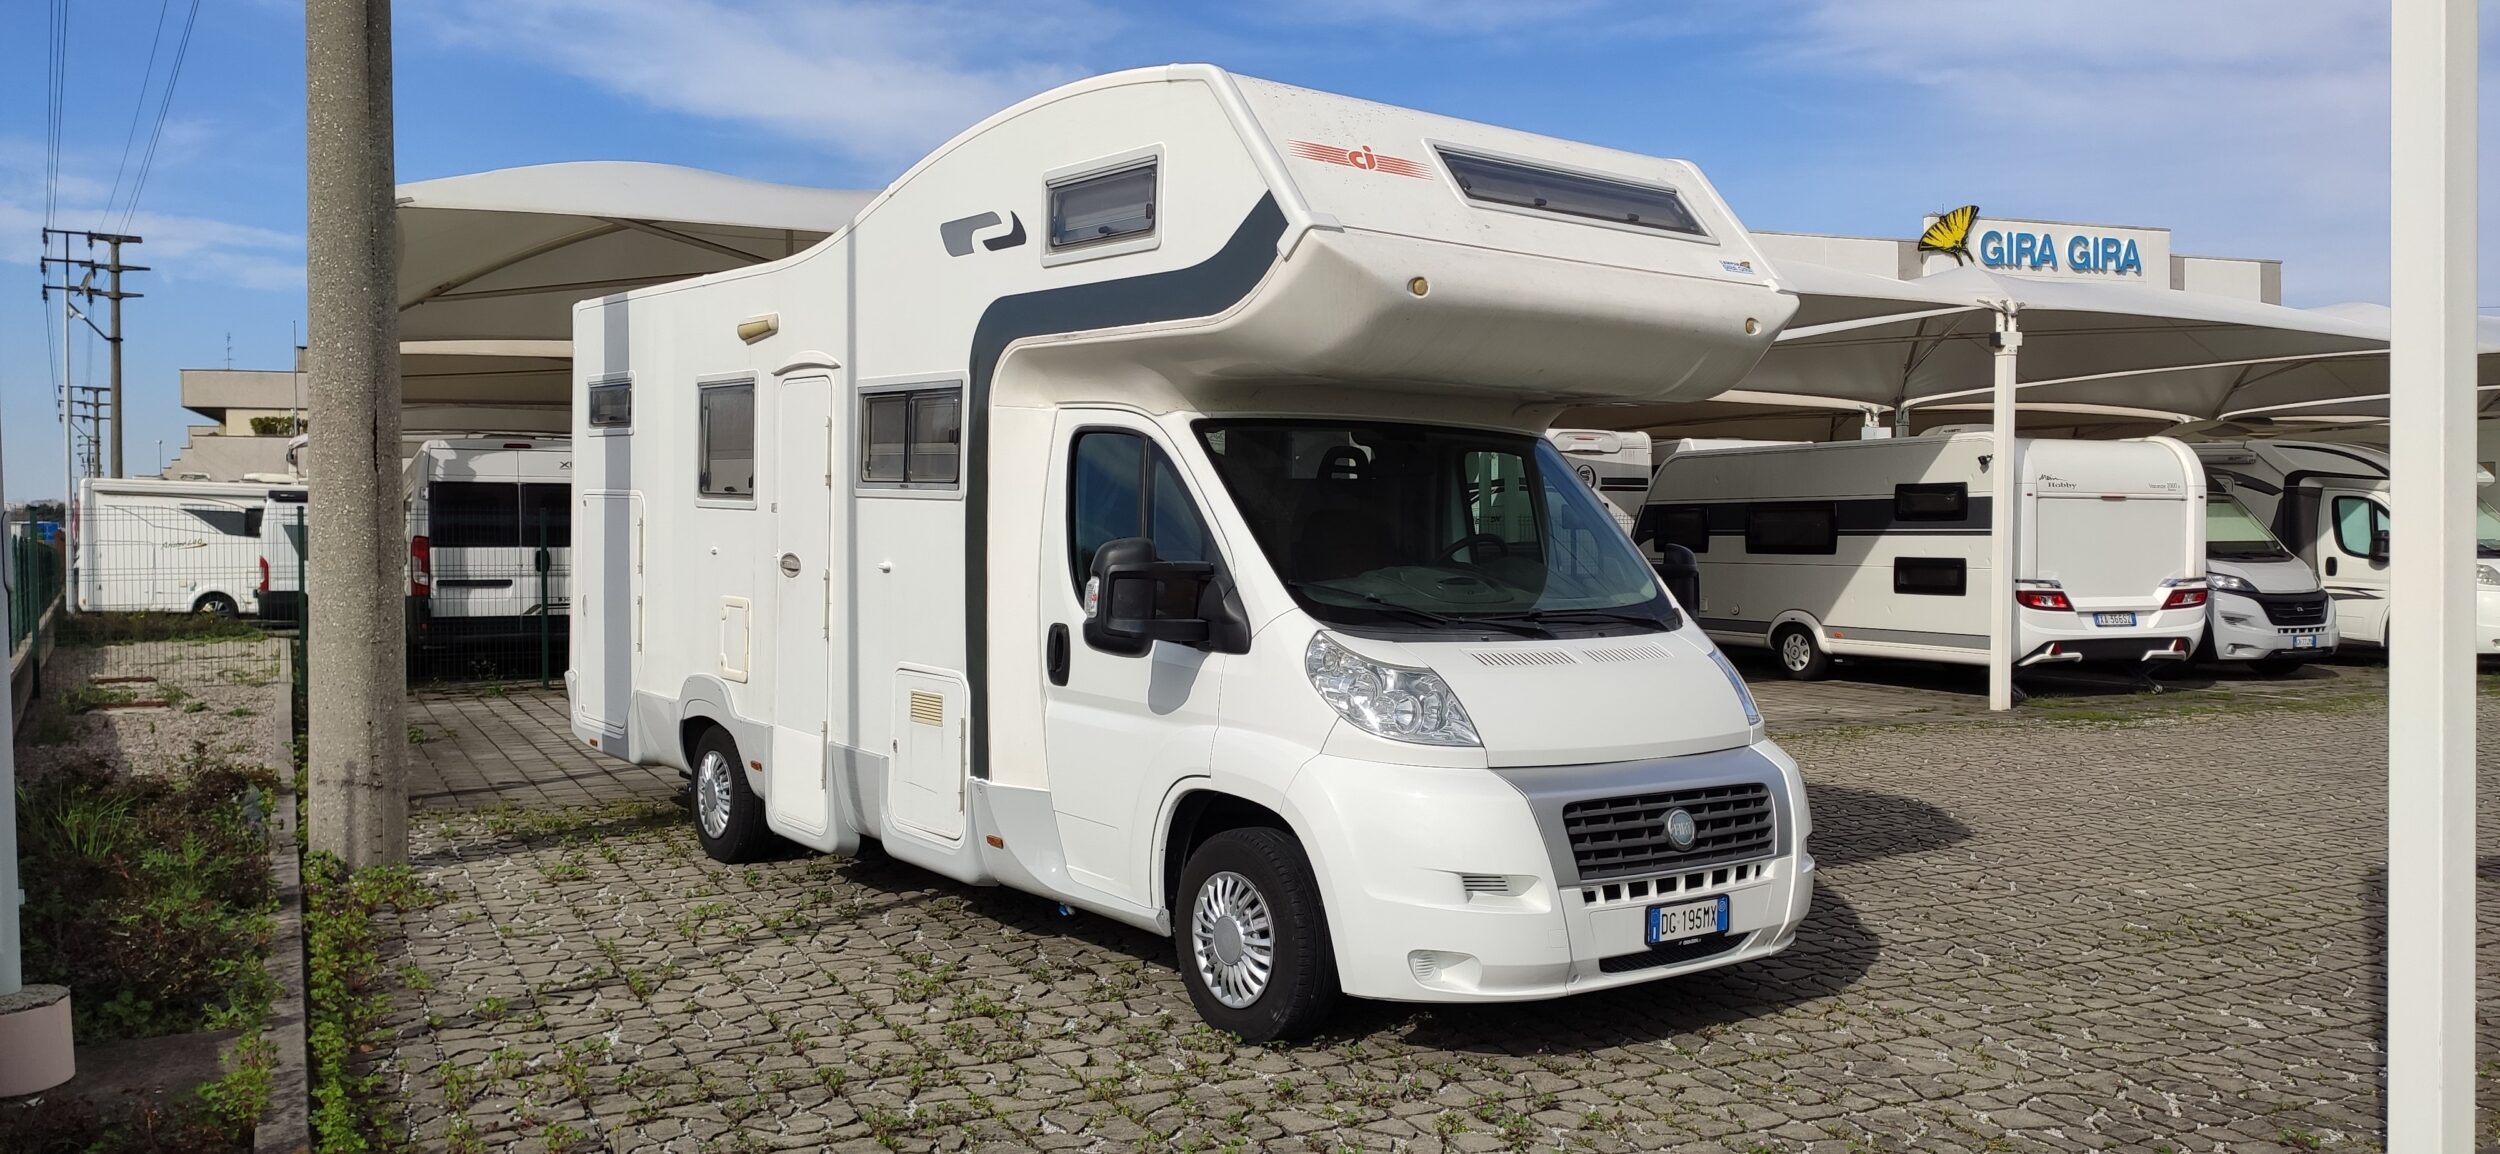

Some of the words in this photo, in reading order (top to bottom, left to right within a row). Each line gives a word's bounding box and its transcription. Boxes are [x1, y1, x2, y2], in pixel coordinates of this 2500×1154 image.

[1348, 145, 1377, 170] ci
[1980, 230, 2058, 271] GIRA
[2067, 235, 2143, 276] GIRA
[2048, 482, 2077, 490] Hobby
[1661, 912, 1676, 935] DG
[1683, 905, 1717, 932] 195MX
